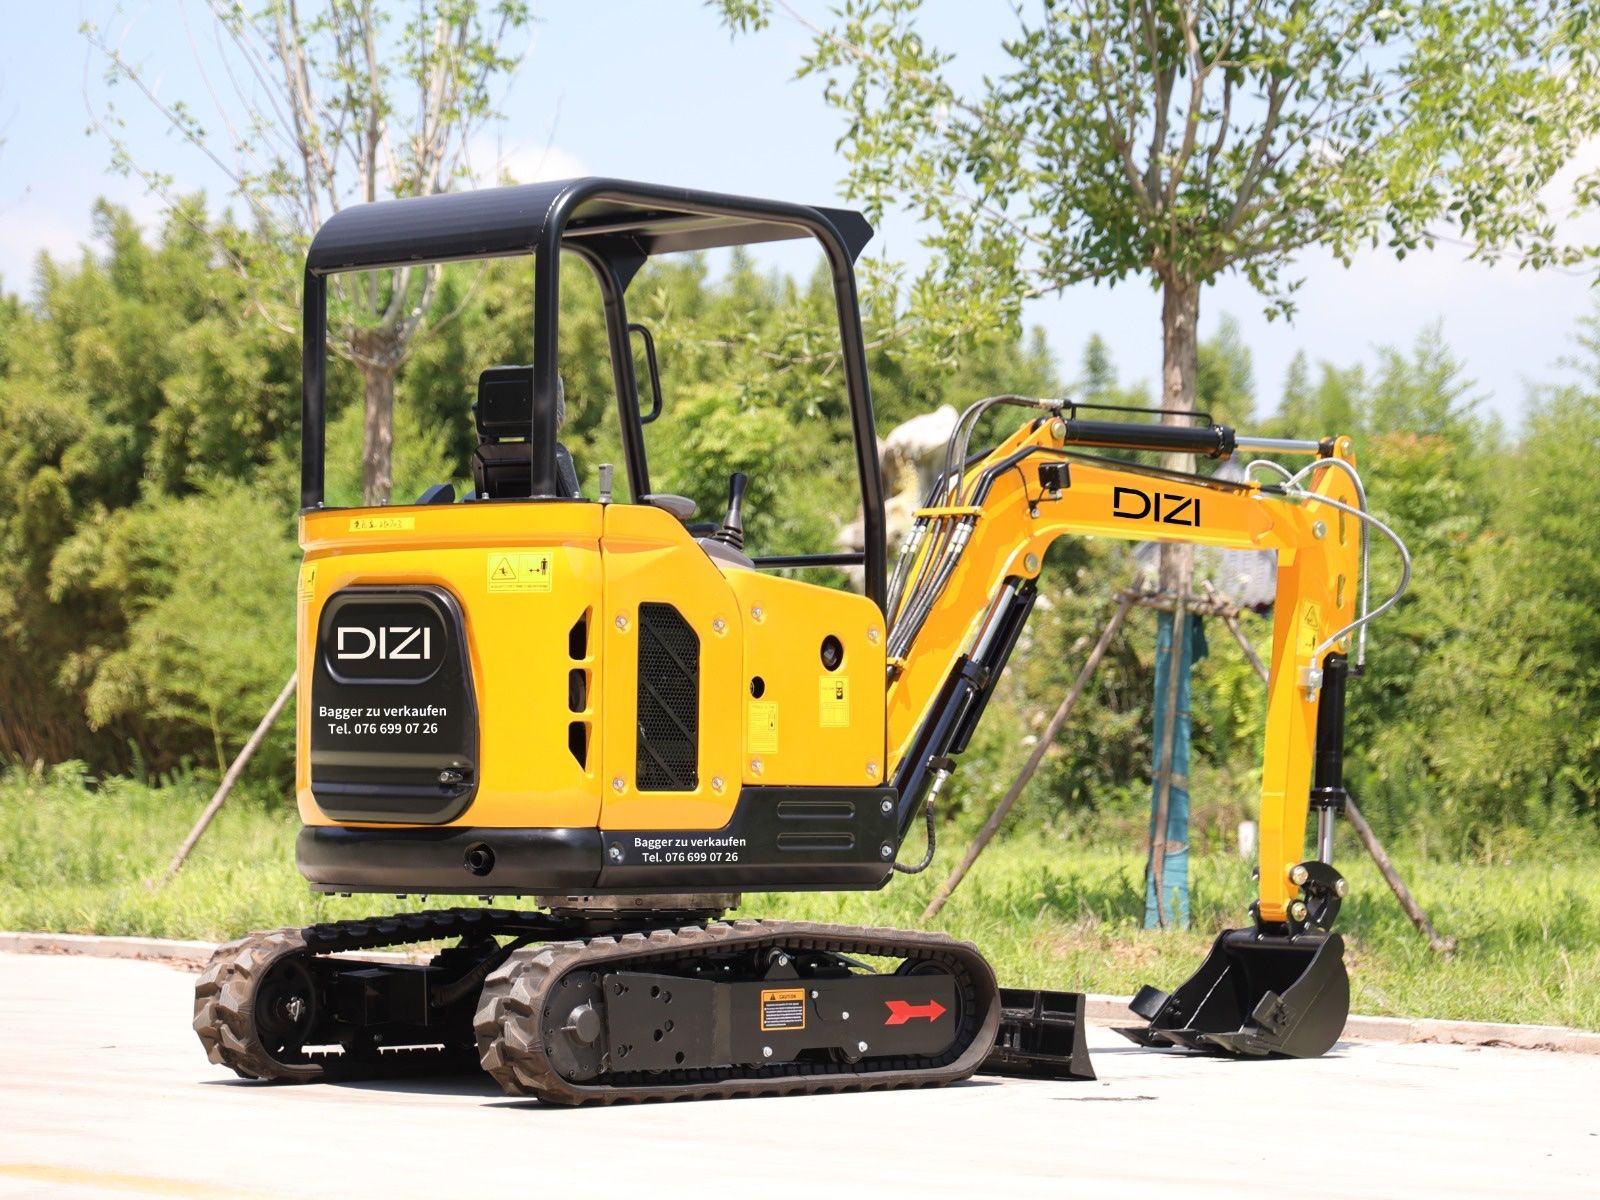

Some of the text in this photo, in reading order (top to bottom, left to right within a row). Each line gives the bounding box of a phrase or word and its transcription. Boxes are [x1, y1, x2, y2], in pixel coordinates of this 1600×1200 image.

[1113, 487, 1201, 527] DIZI
[337, 627, 431, 659] DIZI
[319, 705, 447, 720] Bagger zu verkaufen
[327, 722, 438, 735] Tel. 076 699 07 26
[634, 836, 746, 849] Bagger zu verkaufen
[642, 852, 738, 862] Tel. 076 699 07 26
